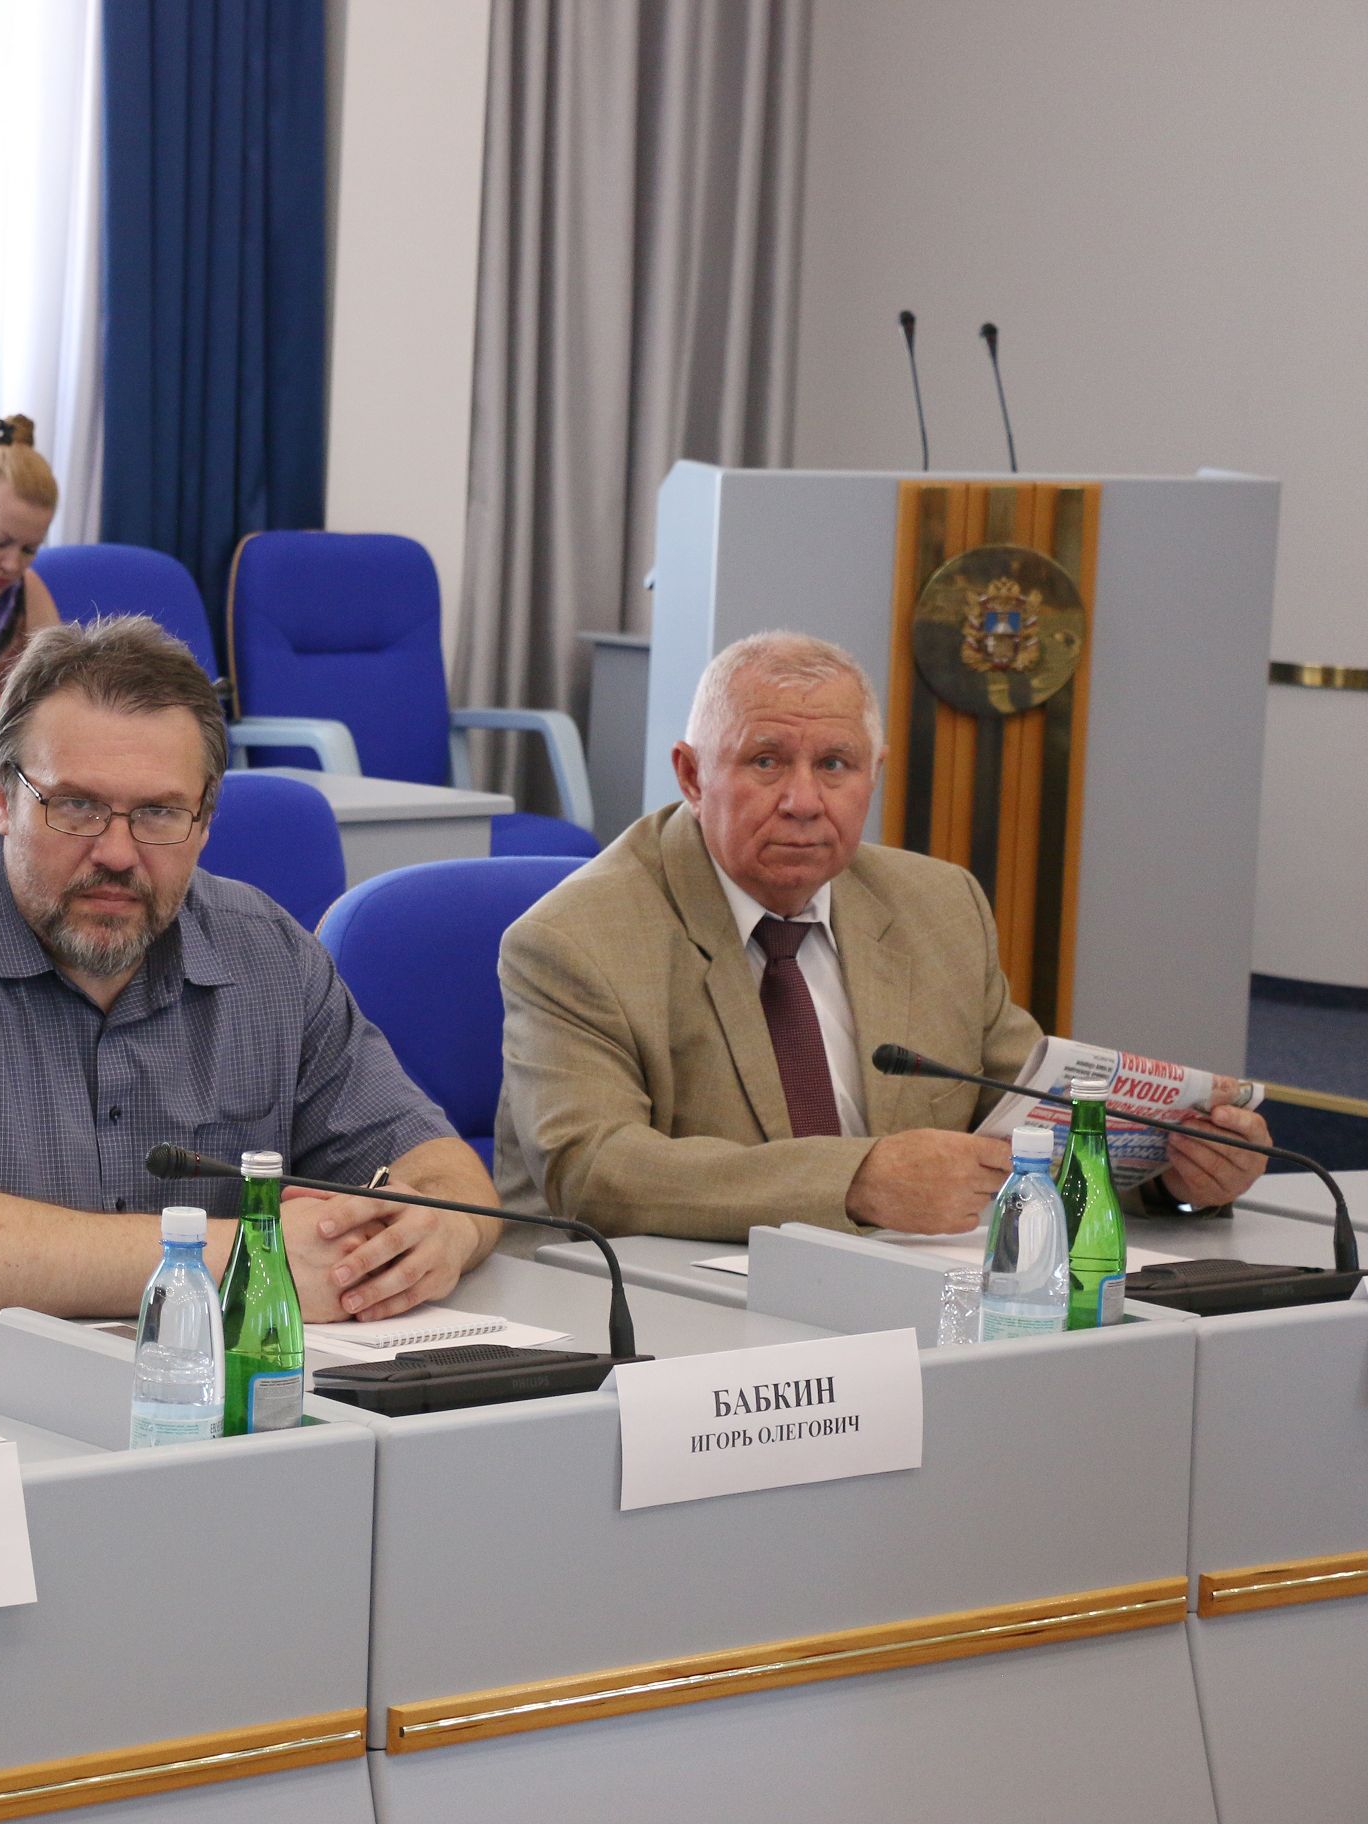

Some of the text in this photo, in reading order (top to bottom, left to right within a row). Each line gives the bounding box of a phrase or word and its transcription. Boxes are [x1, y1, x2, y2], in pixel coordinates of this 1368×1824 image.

[1112, 1074, 1181, 1105] ЭПОХА
[711, 1375, 837, 1418] БАБКИН
[690, 1414, 861, 1454] ИГОРЬ ОЛЕГОВИЧ
